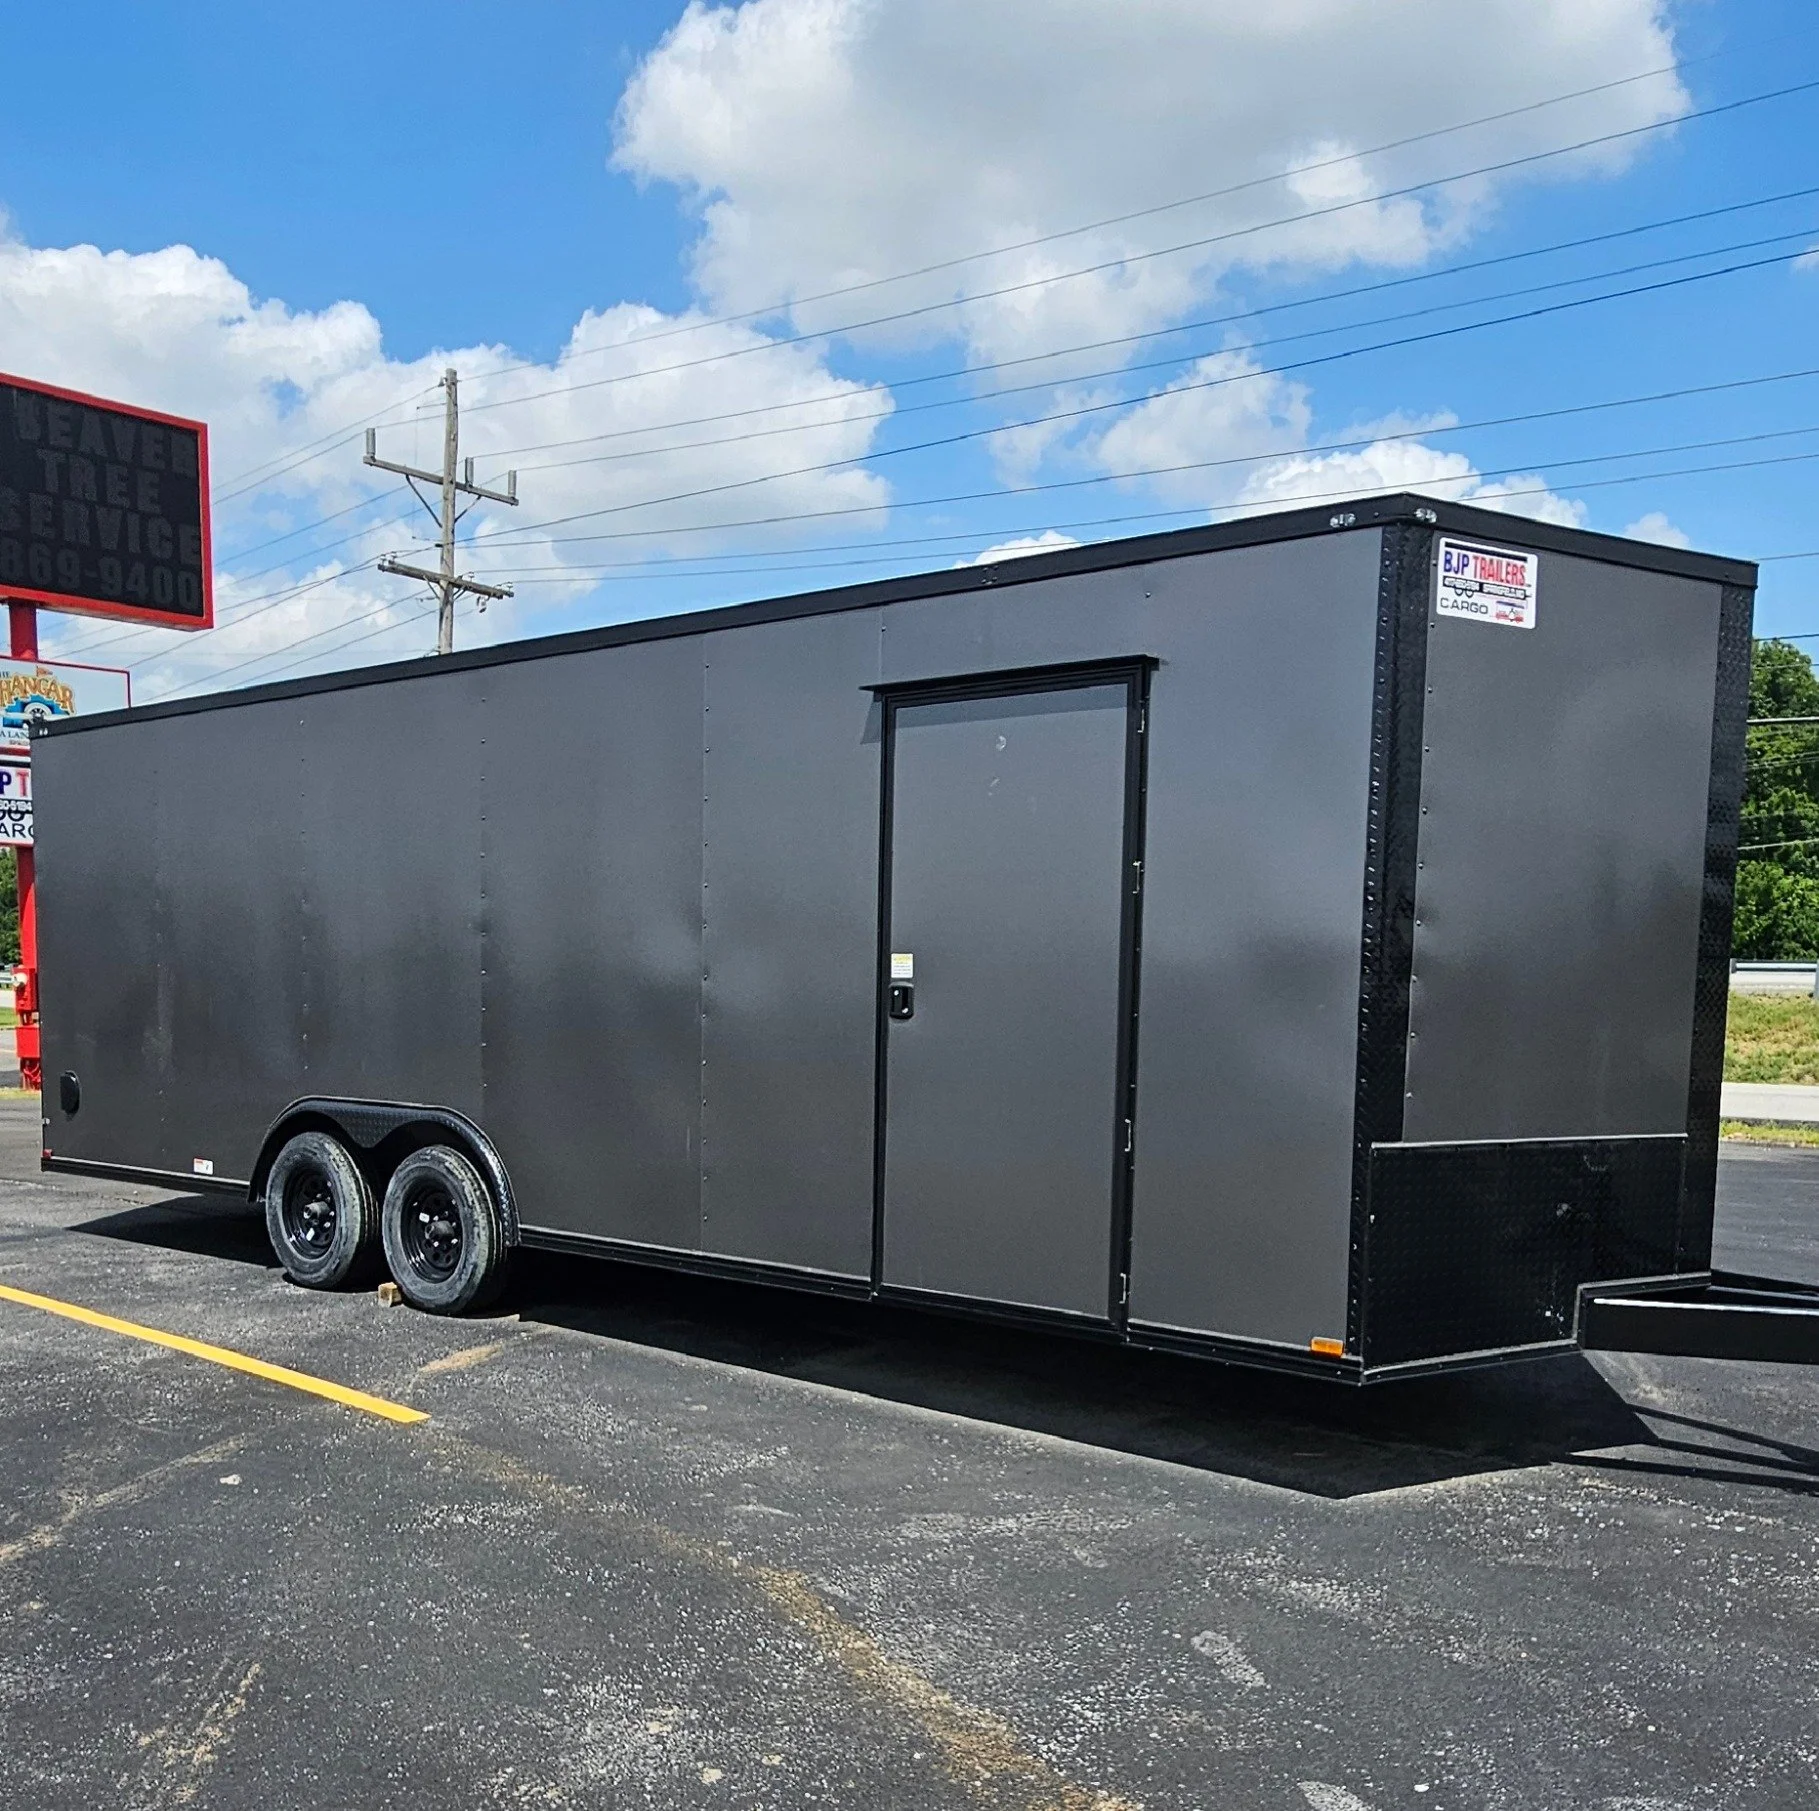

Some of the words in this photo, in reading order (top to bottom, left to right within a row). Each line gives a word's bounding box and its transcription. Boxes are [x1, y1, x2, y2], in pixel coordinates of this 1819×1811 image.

[37, 448, 162, 513] TREE
[0, 486, 201, 566] SERVICE
[0, 536, 200, 611] 869-9400
[1444, 551, 1469, 576] BJP
[1472, 555, 1527, 586] TRAILERS
[1440, 598, 1488, 614] CARGO
[0, 674, 74, 714] HANGAR
